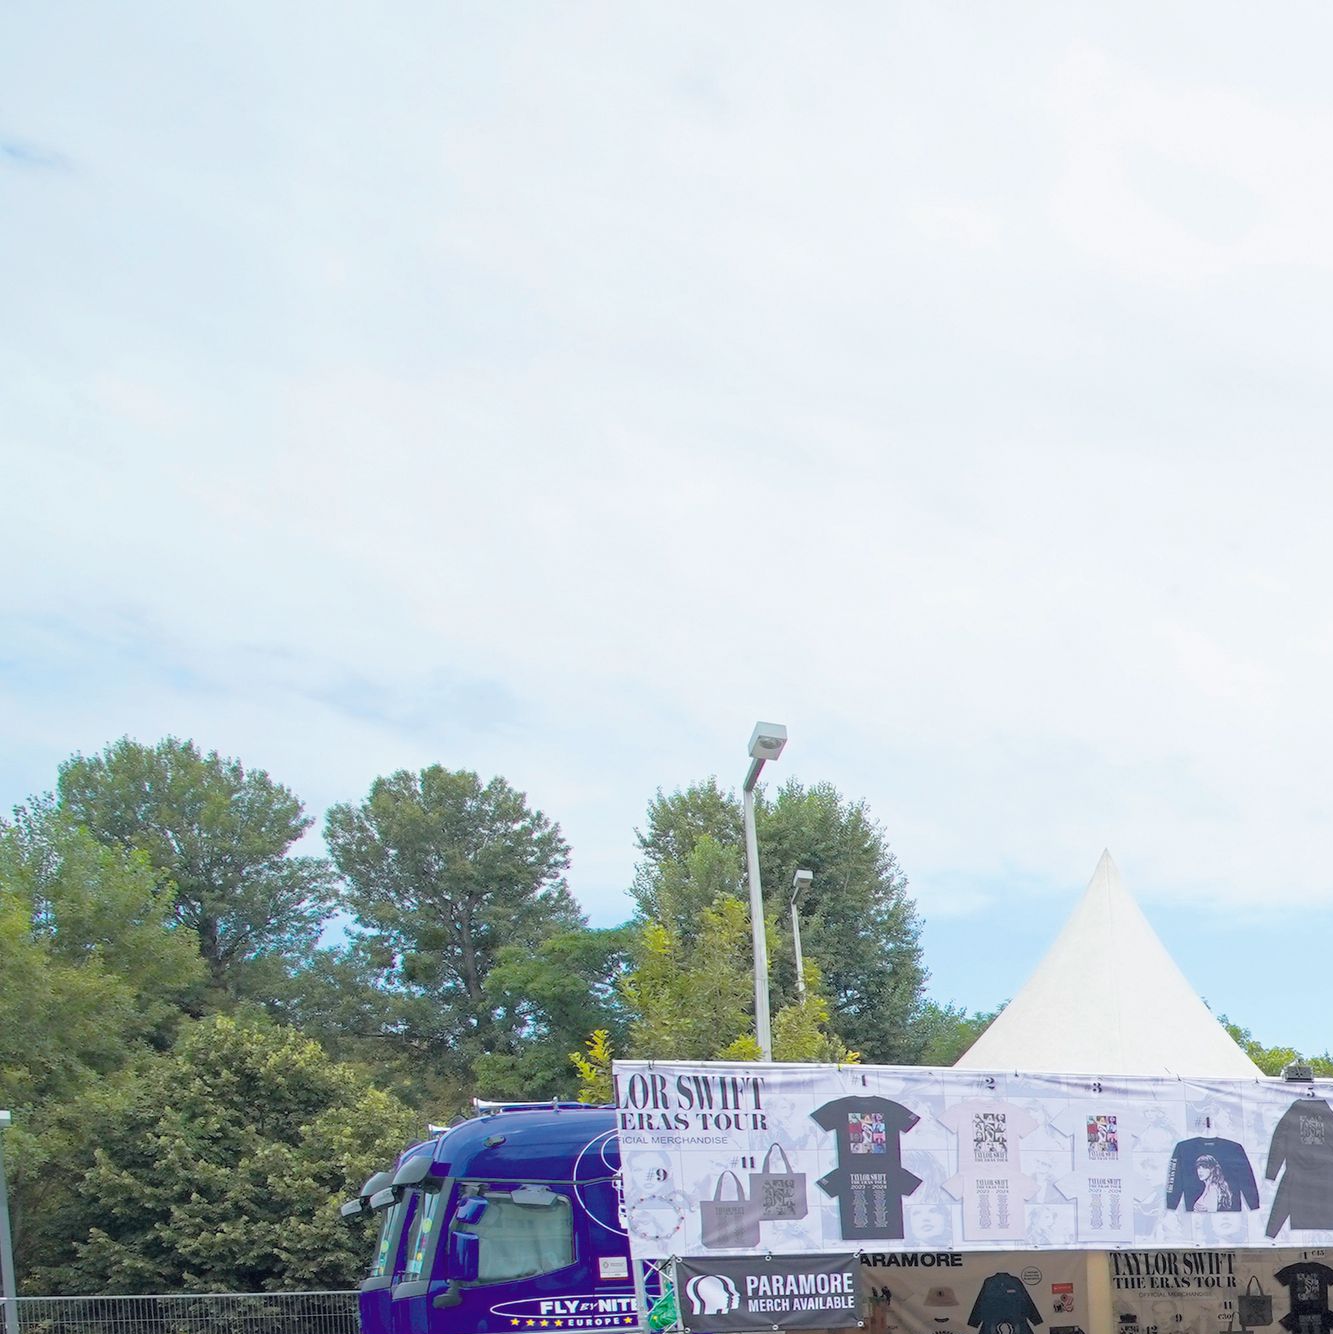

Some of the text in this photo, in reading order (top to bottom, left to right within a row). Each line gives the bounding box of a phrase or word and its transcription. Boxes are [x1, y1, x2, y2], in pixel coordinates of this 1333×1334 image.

[613, 1073, 766, 1111] LOR SWIFT
[1306, 1087, 1316, 1097] 5
[621, 1112, 768, 1131] ERAS TOUR
[651, 1136, 728, 1145] MERCHANDISE
[730, 1156, 755, 1168] #11
[647, 1168, 668, 1182] #9
[1110, 1252, 1236, 1276] TAYLOR SWIFT
[745, 1273, 854, 1297] PARAMORE
[1113, 1276, 1237, 1289] THE ERAS TOUR
[540, 1300, 580, 1315] FLY
[749, 1296, 855, 1313] MERCH AVAILABLE
[1223, 1301, 1233, 1310] 11
[568, 1317, 620, 1327] EUROPE
[1175, 1313, 1182, 1323] 9
[1145, 1325, 1158, 1334] 12
